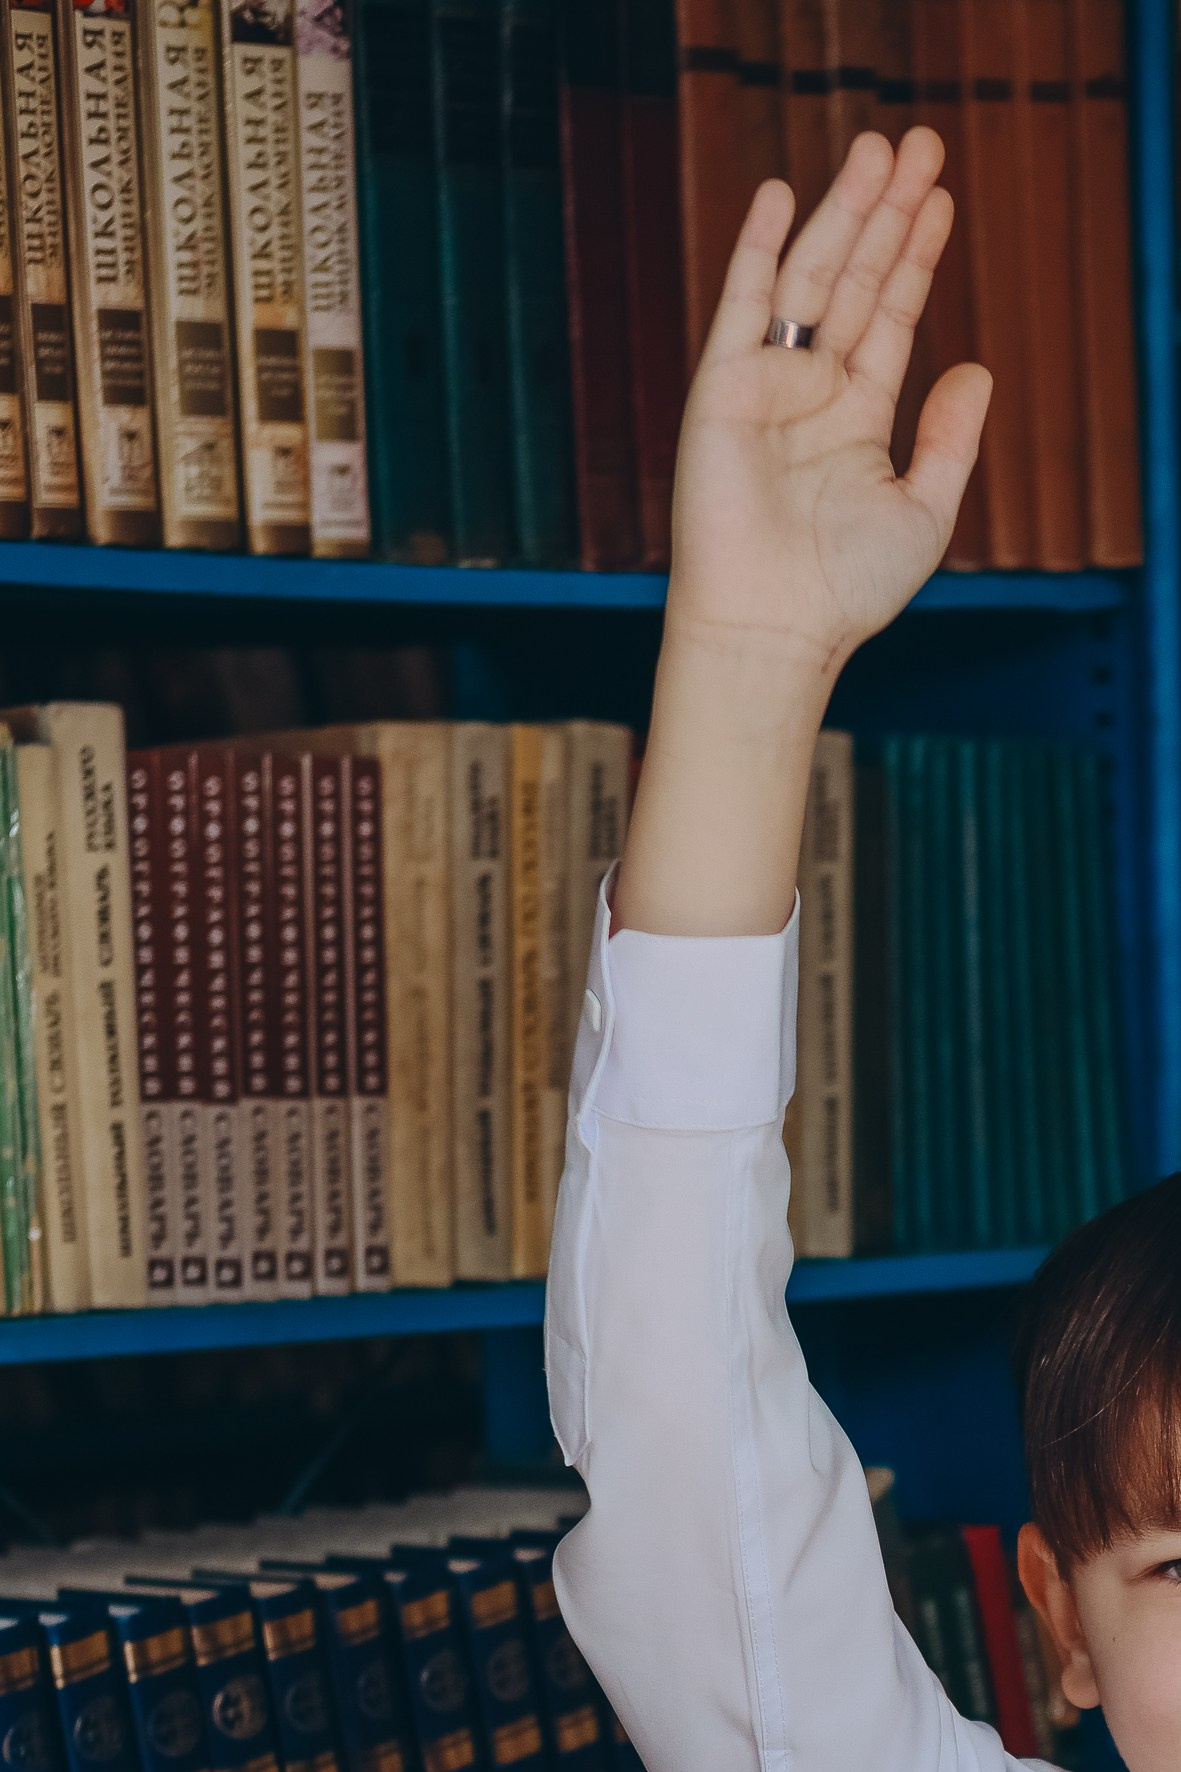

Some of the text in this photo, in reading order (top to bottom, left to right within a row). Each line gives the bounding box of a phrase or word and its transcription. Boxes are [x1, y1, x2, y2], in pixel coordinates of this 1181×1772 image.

[15, 32, 46, 266] ШКОЛЬНАЯ
[83, 26, 117, 285] ШКОЛЬНАЯ
[167, 43, 200, 299] ШКОЛЬНАЯ
[243, 55, 273, 304] ШКОЛЬНАЯ
[307, 91, 333, 312] ШКОЛЬНАЯ
[131, 769, 166, 1251] ОРФОГРАФИЧЕСКИЙ СЛОВАРЬ
[168, 770, 201, 1250] ОРФОГРАФИЧЕСКИЙ СЛОВАРЬ
[204, 776, 236, 1250] ОРФОГРАФИЧЕСКИЙ СЛОВАРЬ
[242, 770, 273, 1243] ОРФОГРАФИЧЕСКИЙ СЛОВАРЬ
[278, 776, 307, 1246] ОРФОГРАФИЧЕСКИЙ СЛОВАРЬ
[317, 776, 343, 1242] ОРФОГРАФИЧЕСКИЙ СЛОВАРЬ
[356, 776, 384, 1240] ОРФОГРАФИЧЕСКИЙ СЛОВАРЬ
